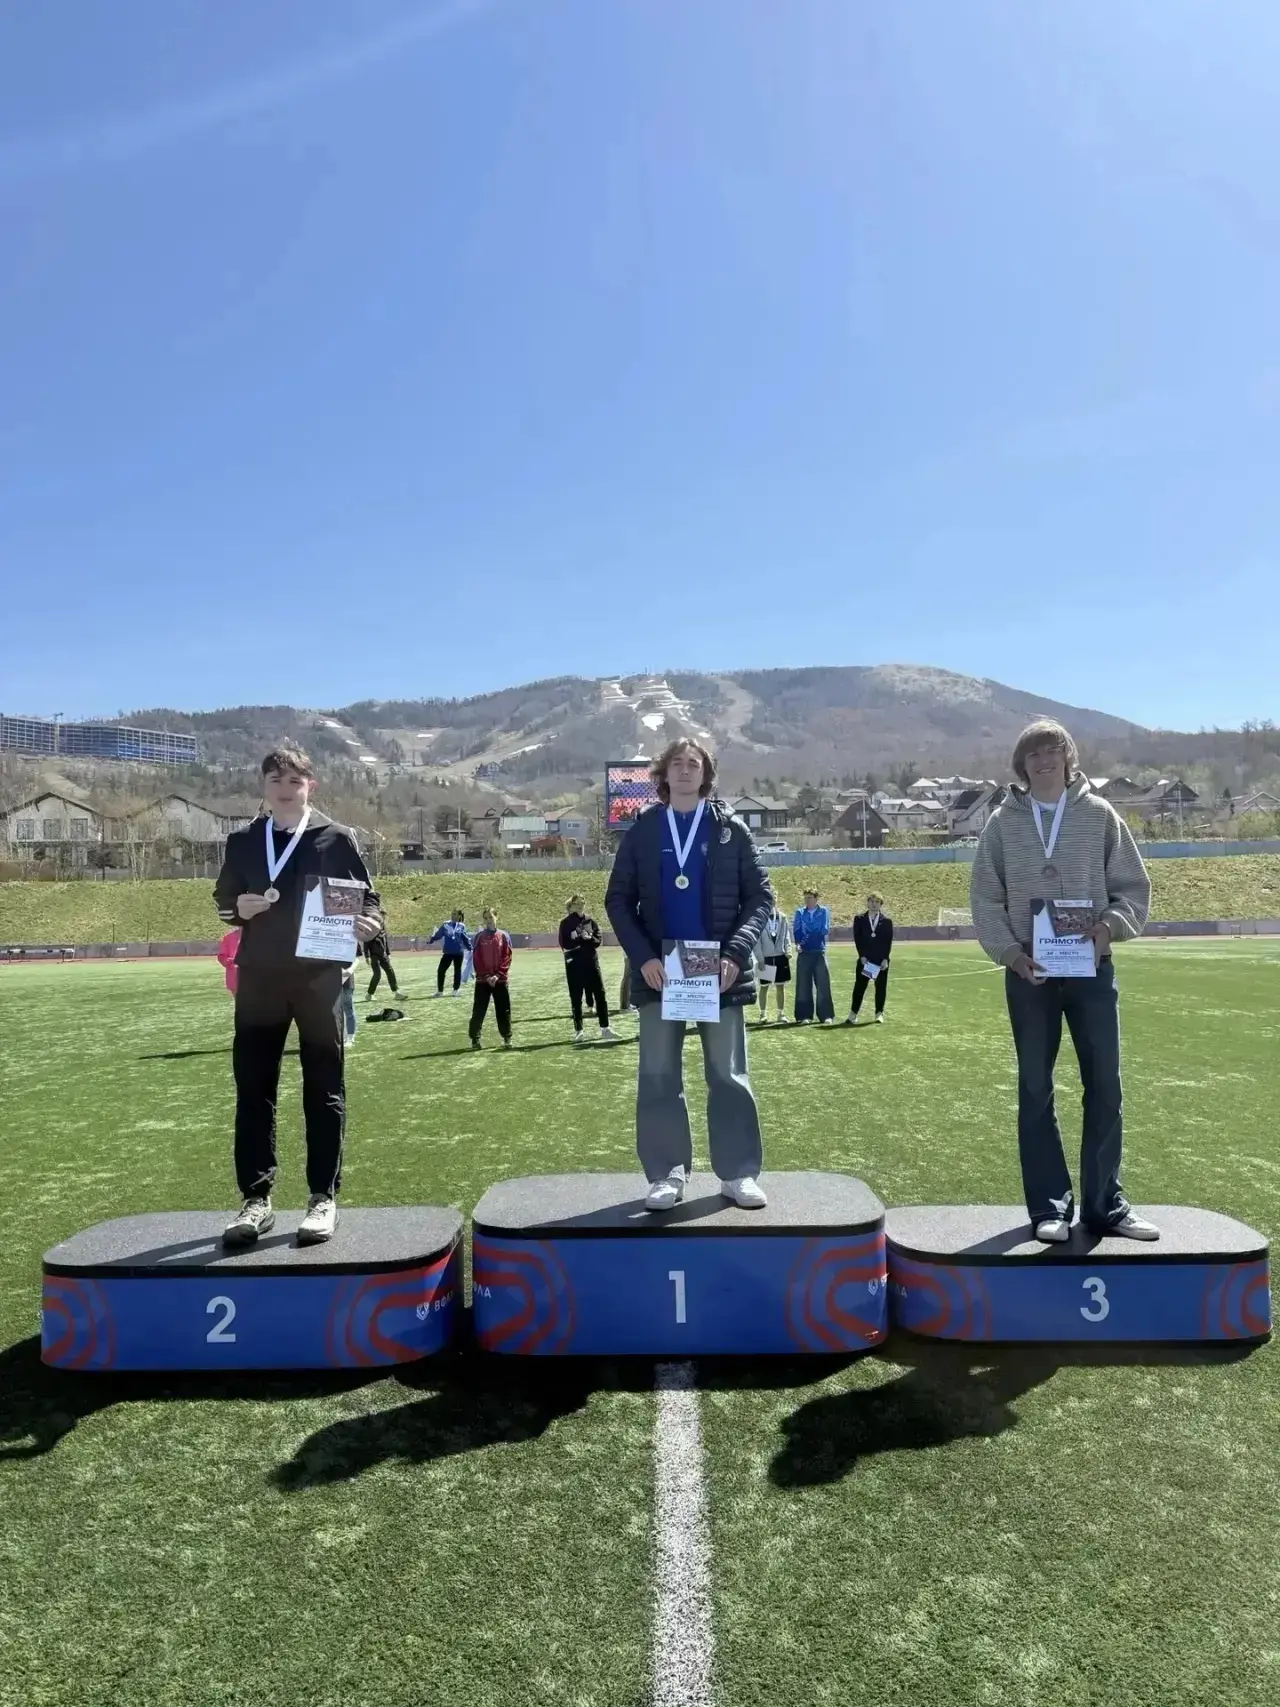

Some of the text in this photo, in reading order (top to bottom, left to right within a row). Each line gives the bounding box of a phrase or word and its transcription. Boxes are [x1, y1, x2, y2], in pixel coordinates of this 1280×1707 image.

[307, 915, 353, 926] ГРАМОТА
[669, 979, 712, 987] ГРАМОТА
[205, 1295, 237, 1344] 2
[668, 1270, 687, 1324] 1
[1079, 1276, 1110, 1323] 3
